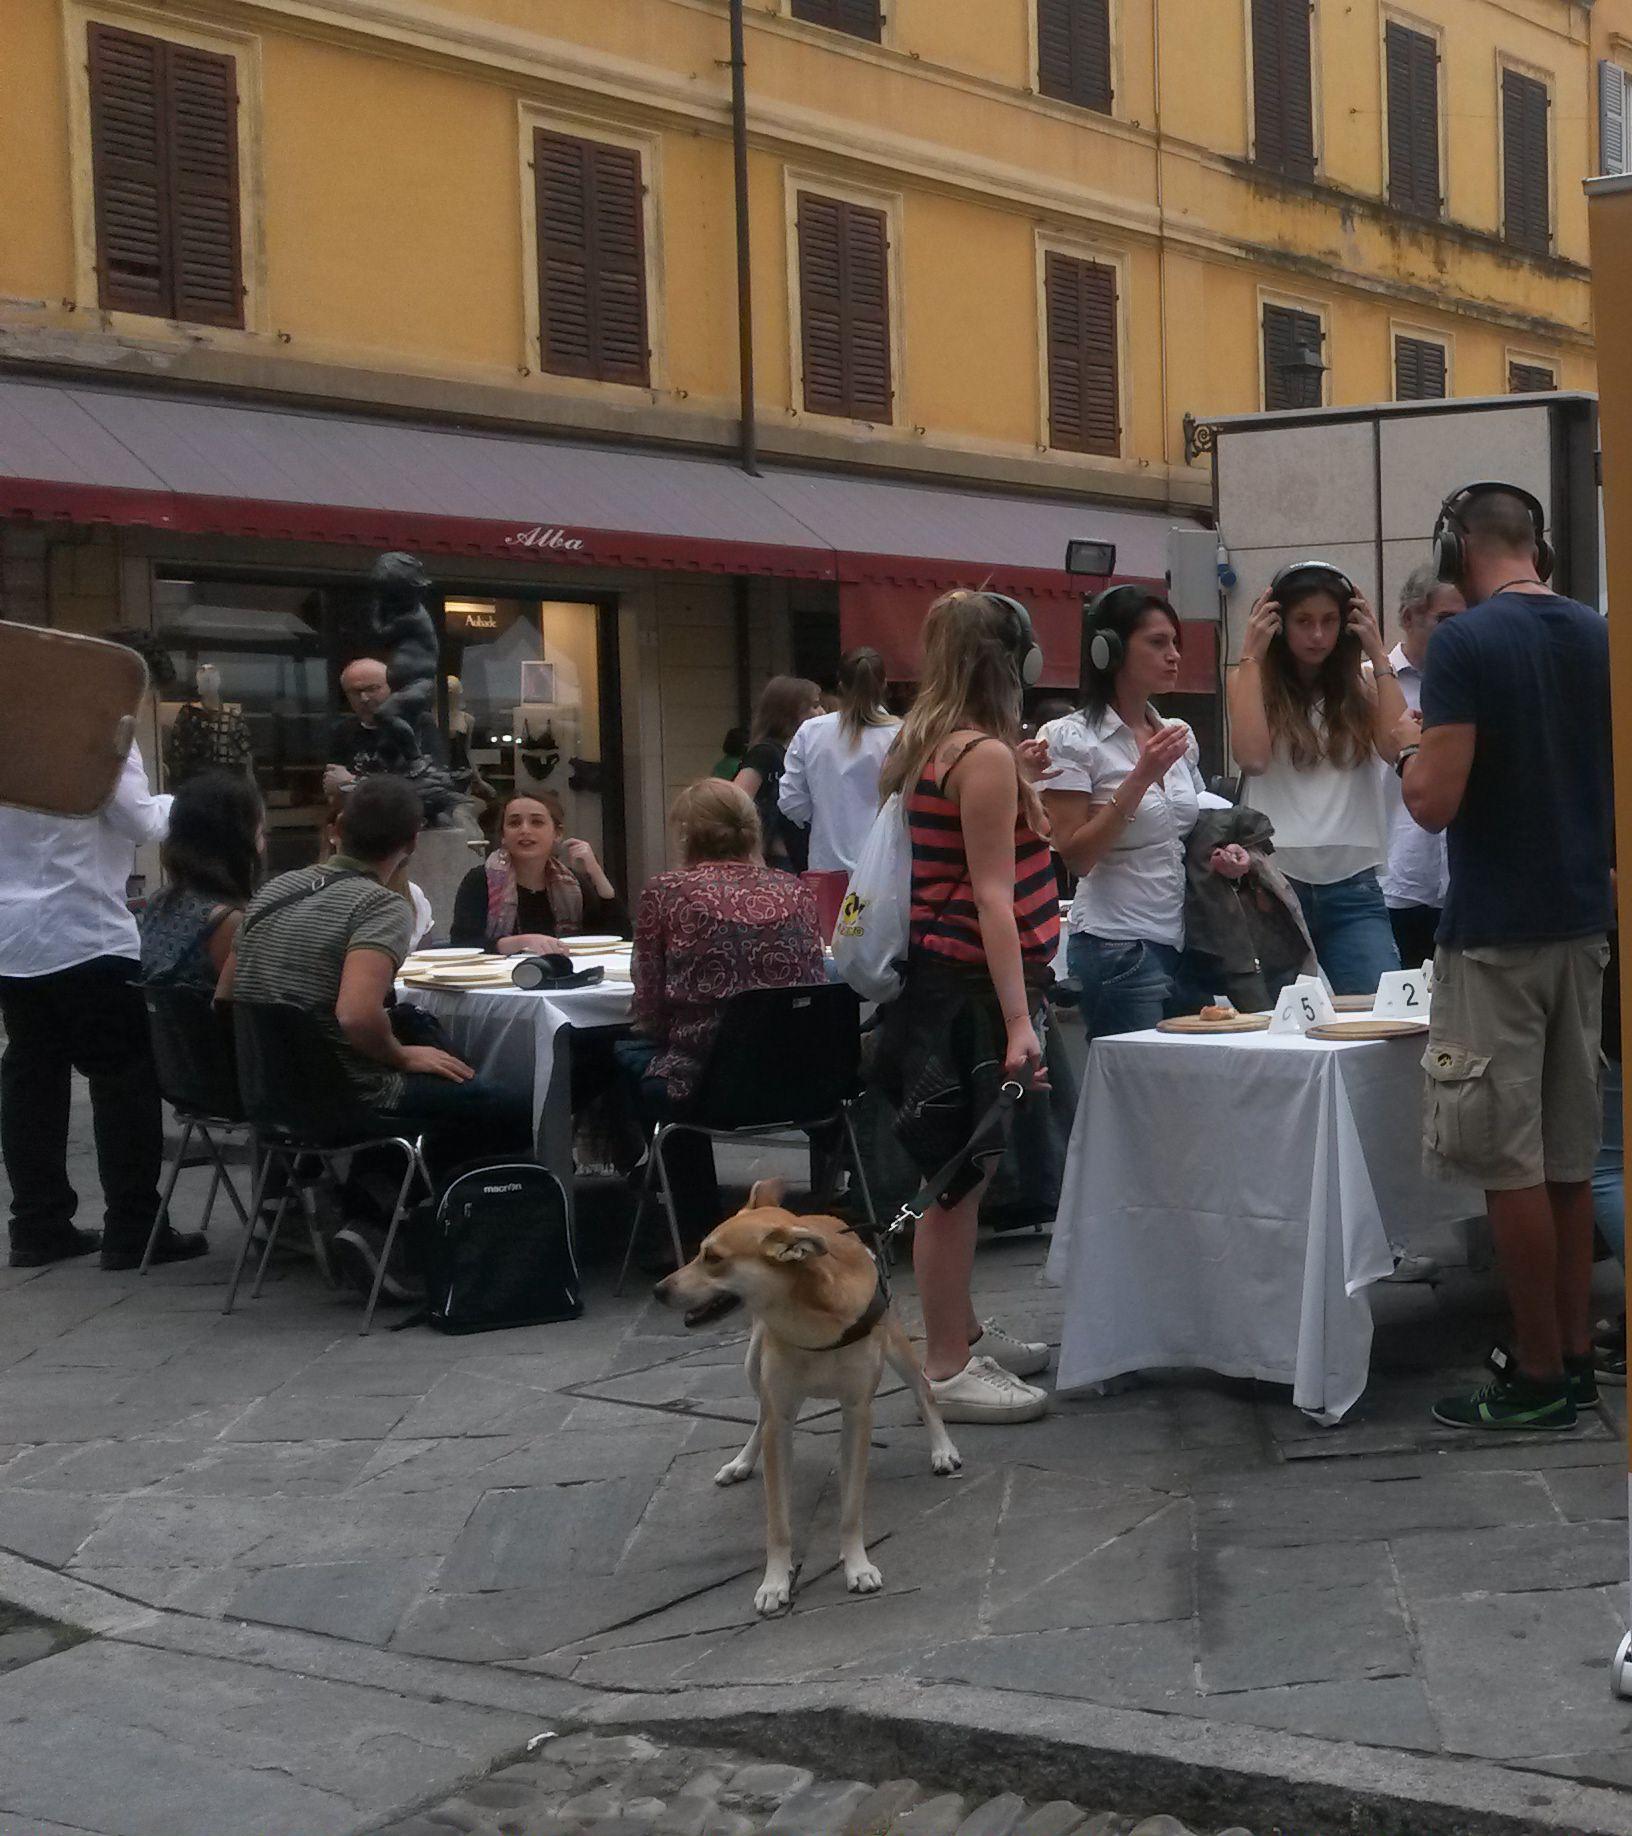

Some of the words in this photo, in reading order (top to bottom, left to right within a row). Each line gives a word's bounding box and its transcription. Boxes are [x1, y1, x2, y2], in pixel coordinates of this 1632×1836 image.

[504, 526, 585, 551] Alba
[1402, 982, 1419, 1006] 2
[1301, 997, 1315, 1022] 5
